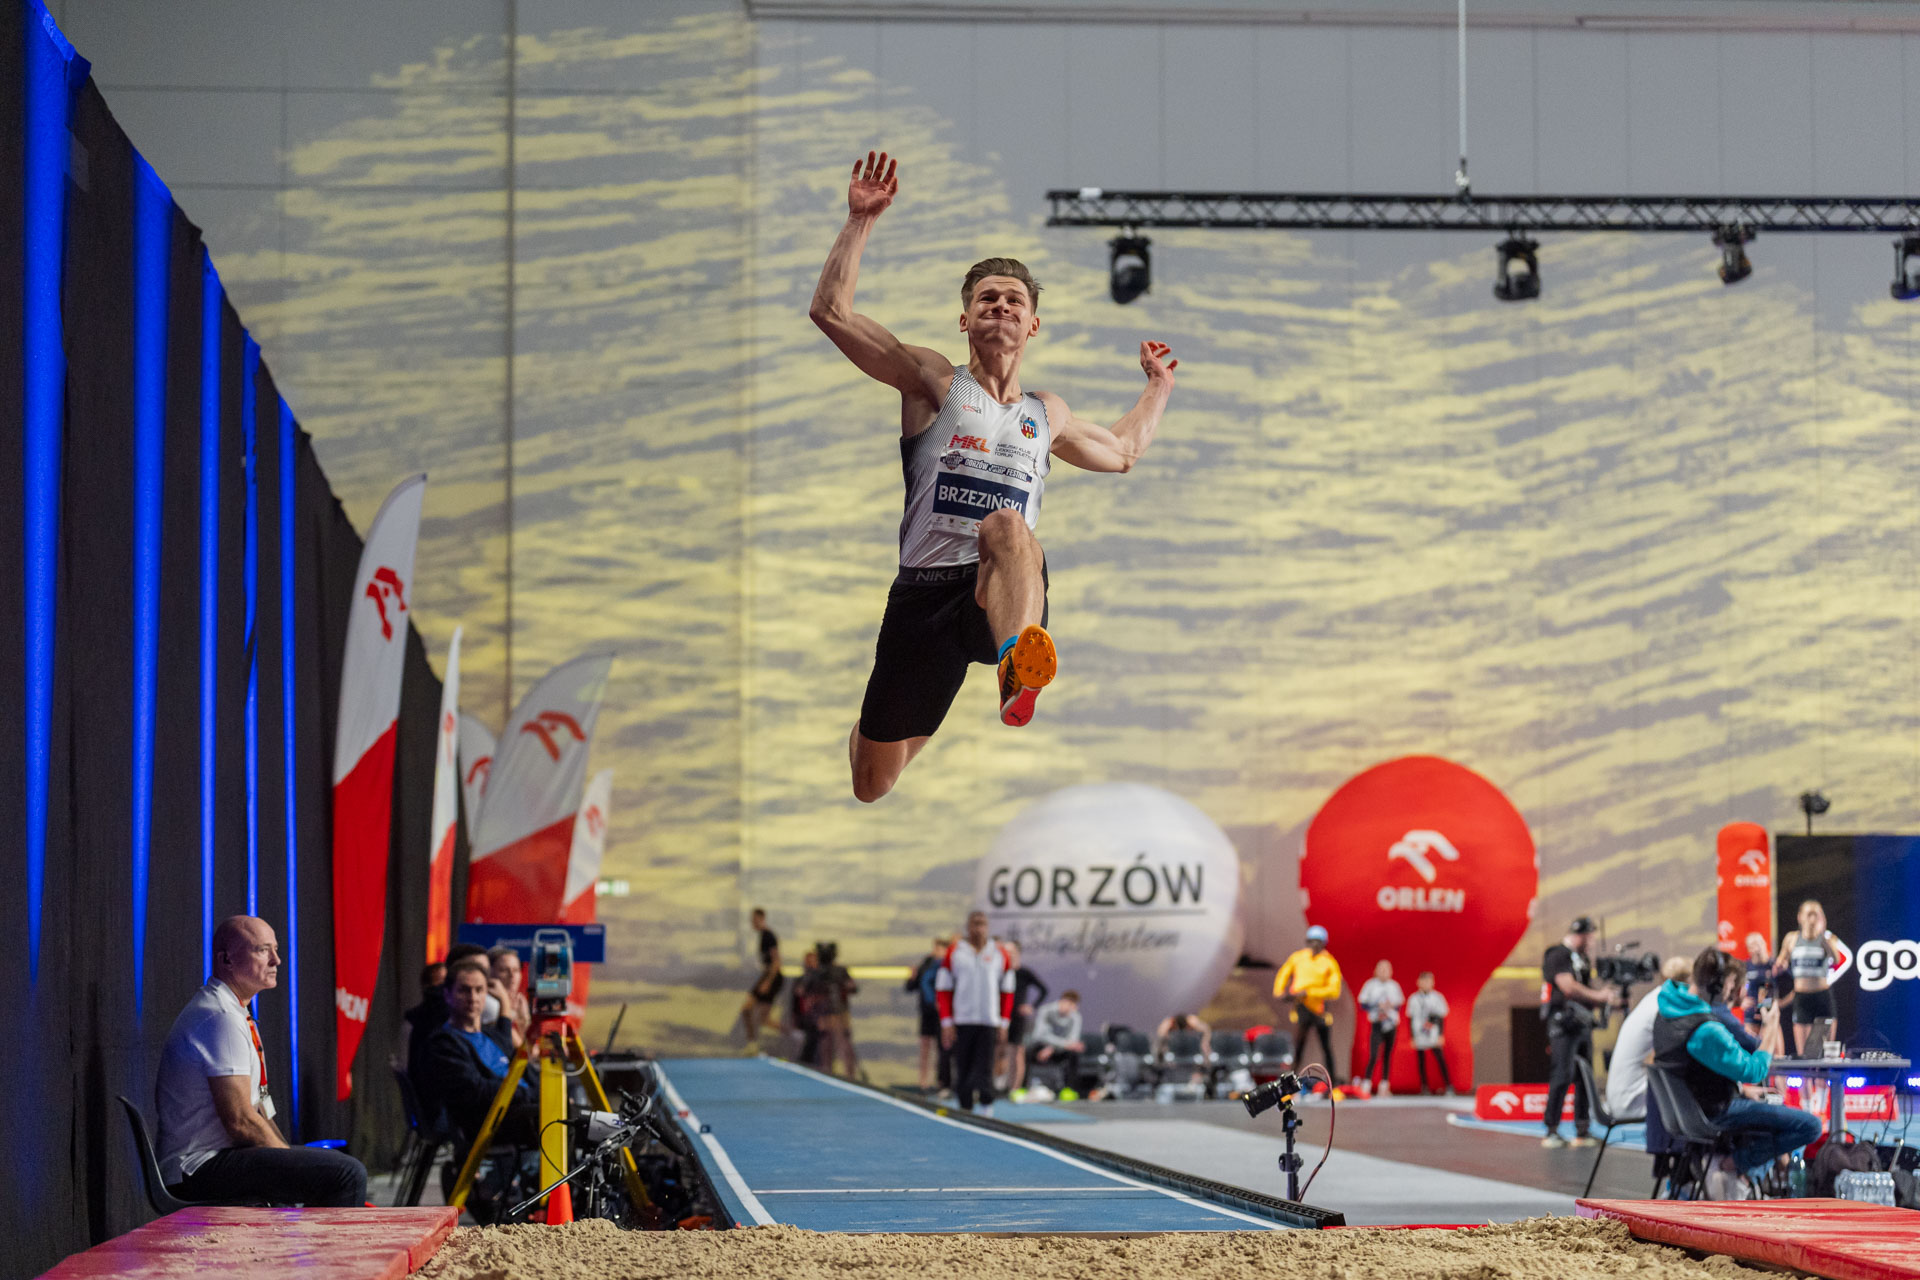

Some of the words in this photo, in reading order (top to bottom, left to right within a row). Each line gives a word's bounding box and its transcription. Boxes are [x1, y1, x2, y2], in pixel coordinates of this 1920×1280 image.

[949, 434, 991, 454] MKL
[1006, 468, 1028, 482] FESTIVAL
[938, 485, 1023, 514] BRZEZIŃSKI
[916, 569, 960, 582] NIKE
[988, 853, 1205, 908] GORZÓW
[1376, 886, 1466, 912] ORLEN
